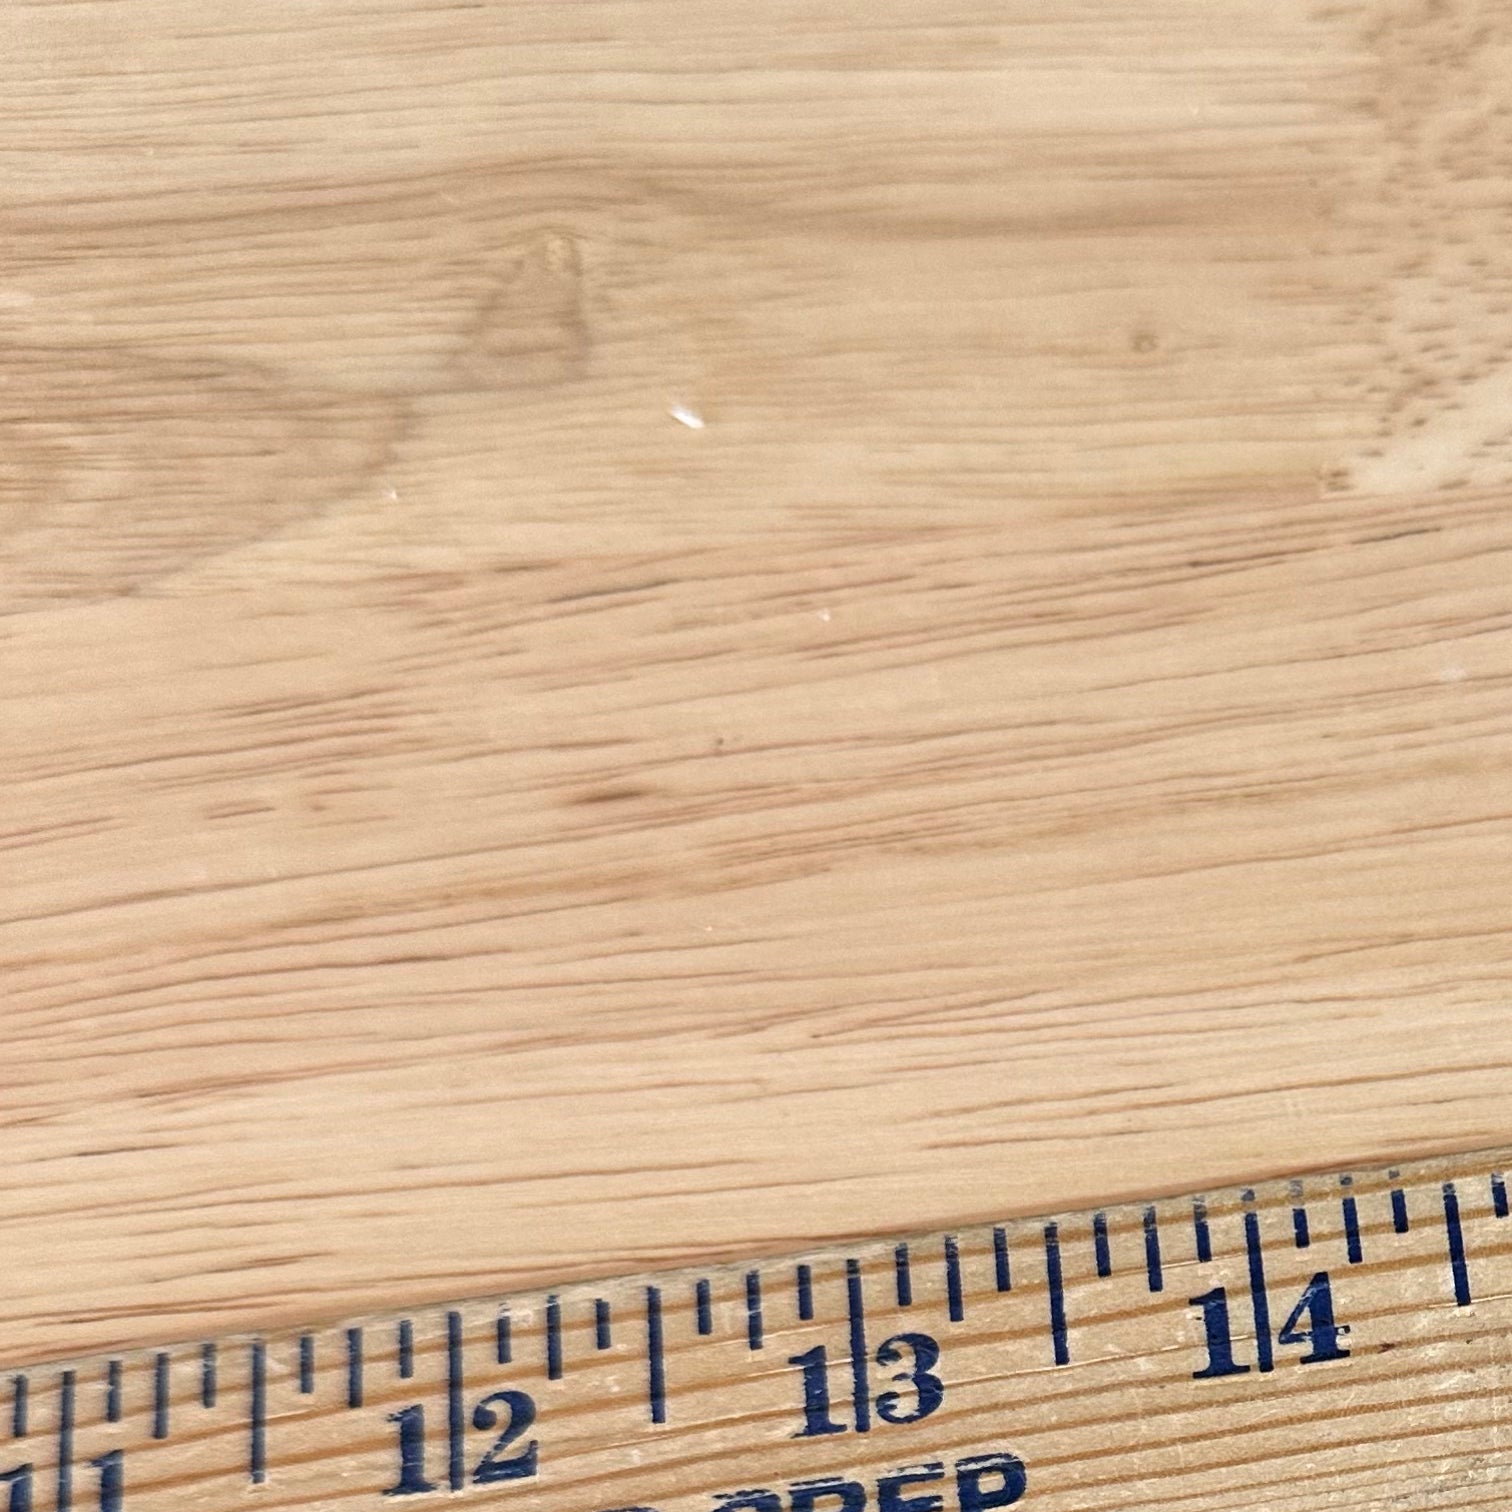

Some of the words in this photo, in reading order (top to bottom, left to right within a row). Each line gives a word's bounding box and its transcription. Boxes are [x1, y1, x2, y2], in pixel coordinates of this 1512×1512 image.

[382, 1389, 539, 1498] 12
[787, 1331, 945, 1438] 13
[1187, 1270, 1352, 1380] 14
